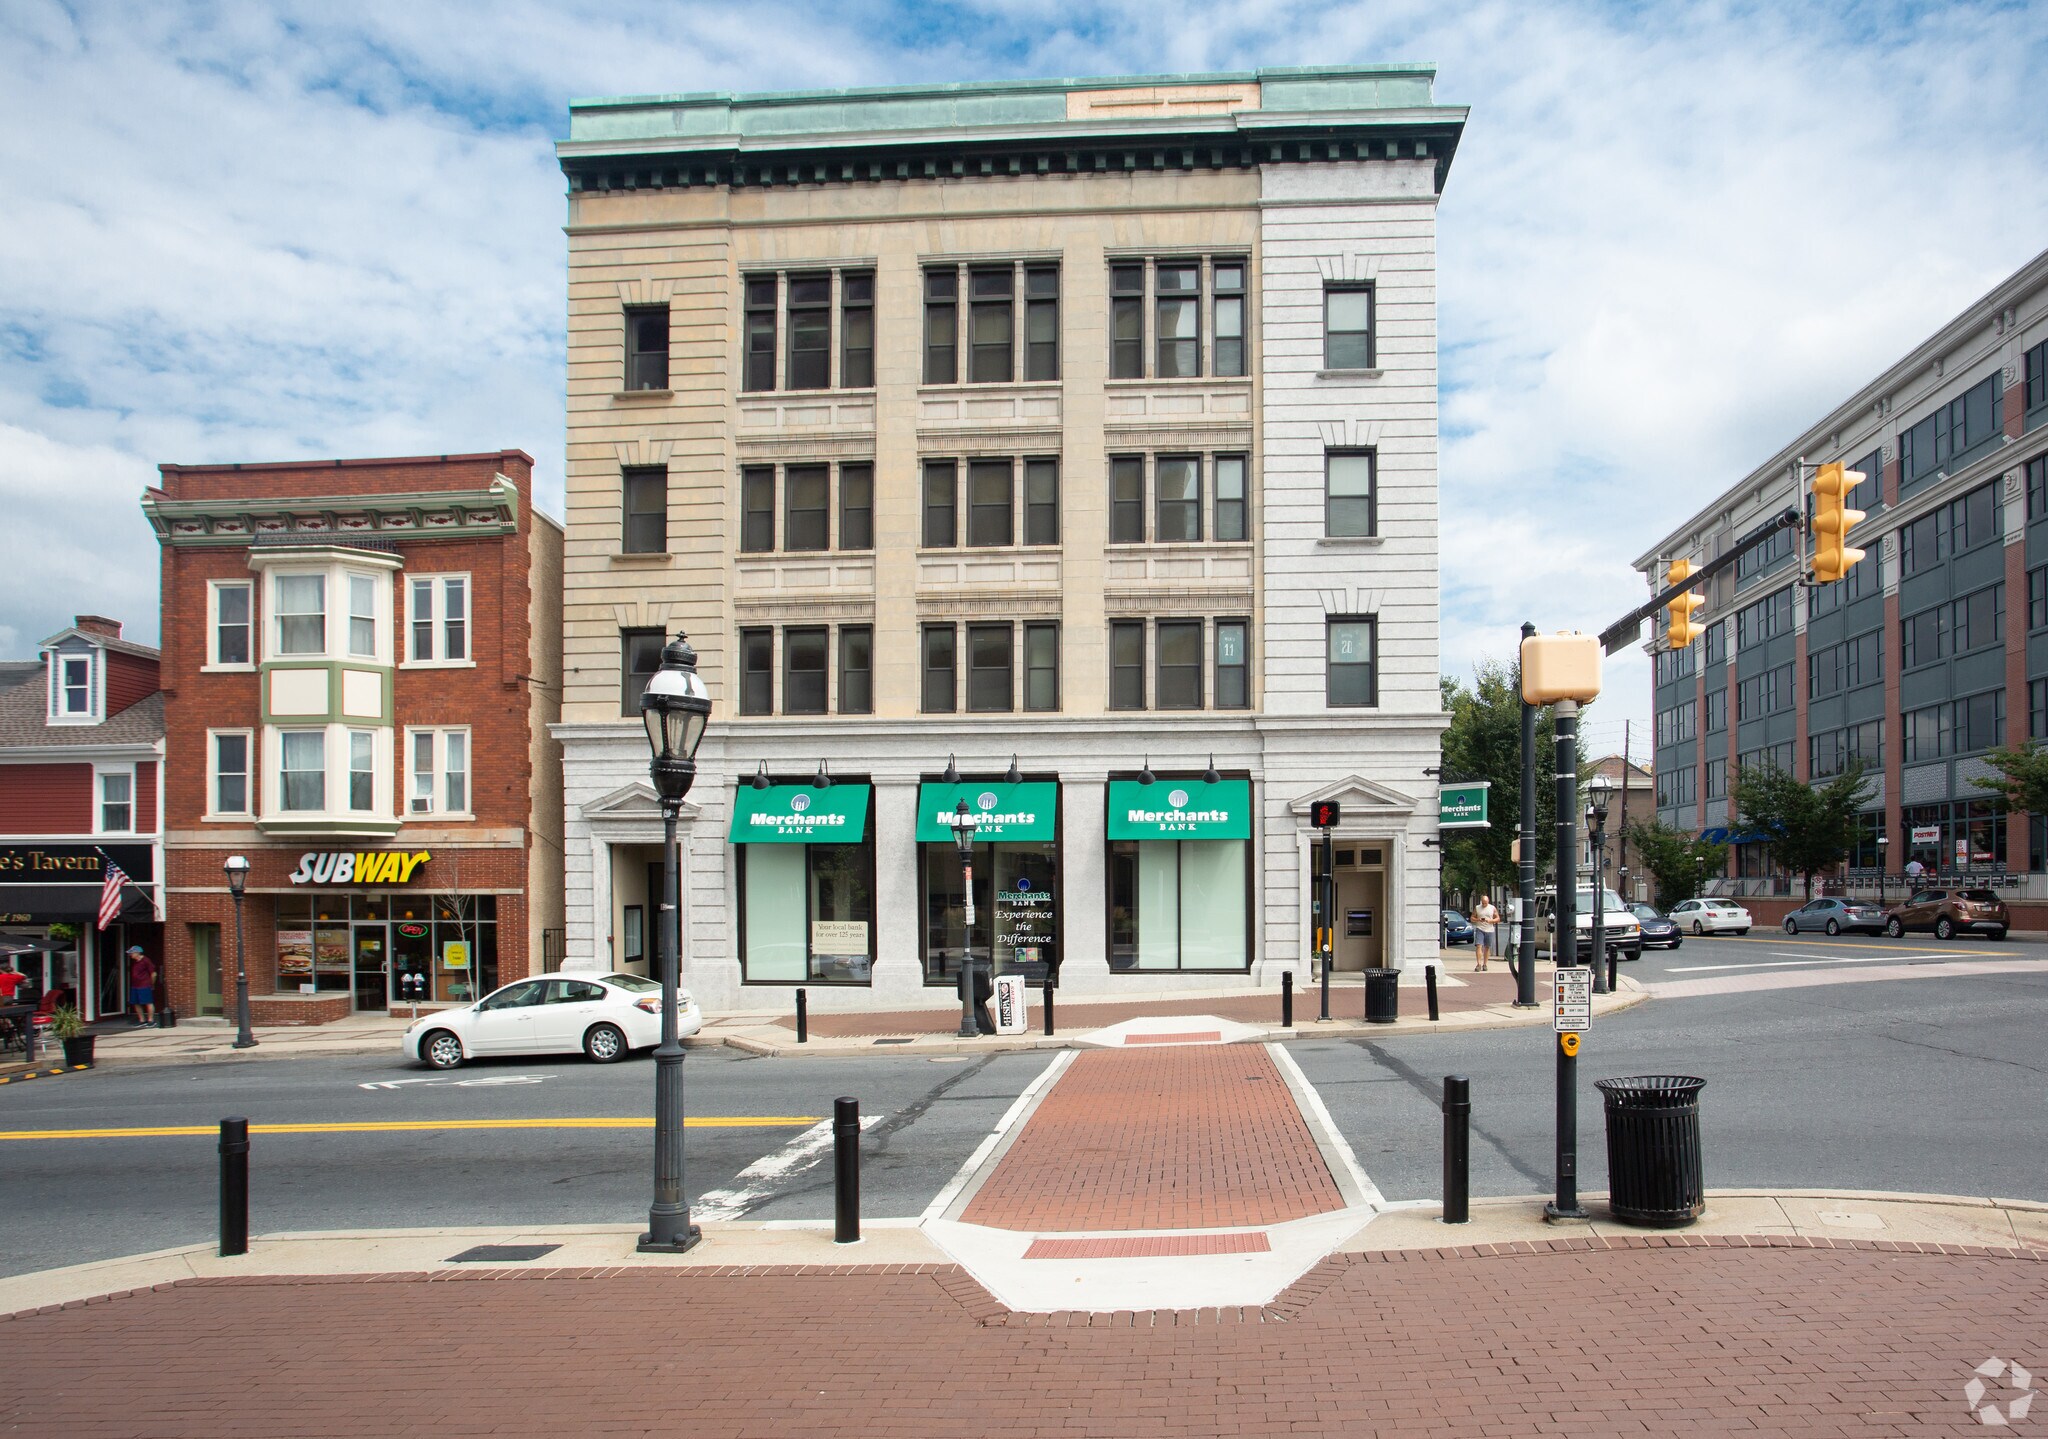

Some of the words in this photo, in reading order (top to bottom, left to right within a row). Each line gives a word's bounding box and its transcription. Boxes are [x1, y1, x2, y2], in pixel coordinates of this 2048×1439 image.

[1224, 643, 1234, 656] 11
[1441, 804, 1481, 813] Merchants
[749, 812, 846, 825] Merchants
[936, 811, 1036, 824] Mchants
[1128, 809, 1228, 822] Merchants
[778, 826, 814, 834] BANK
[975, 825, 1004, 833] ANK
[1159, 823, 1197, 831] BANK
[28, 851, 100, 870] Tavern
[288, 849, 433, 886] SUBWAY
[997, 890, 1051, 900] Merchants
[994, 909, 1053, 921] Experience
[401, 925, 424, 935] OPEN
[1015, 922, 1032, 931] the
[997, 933, 1052, 946] Difference
